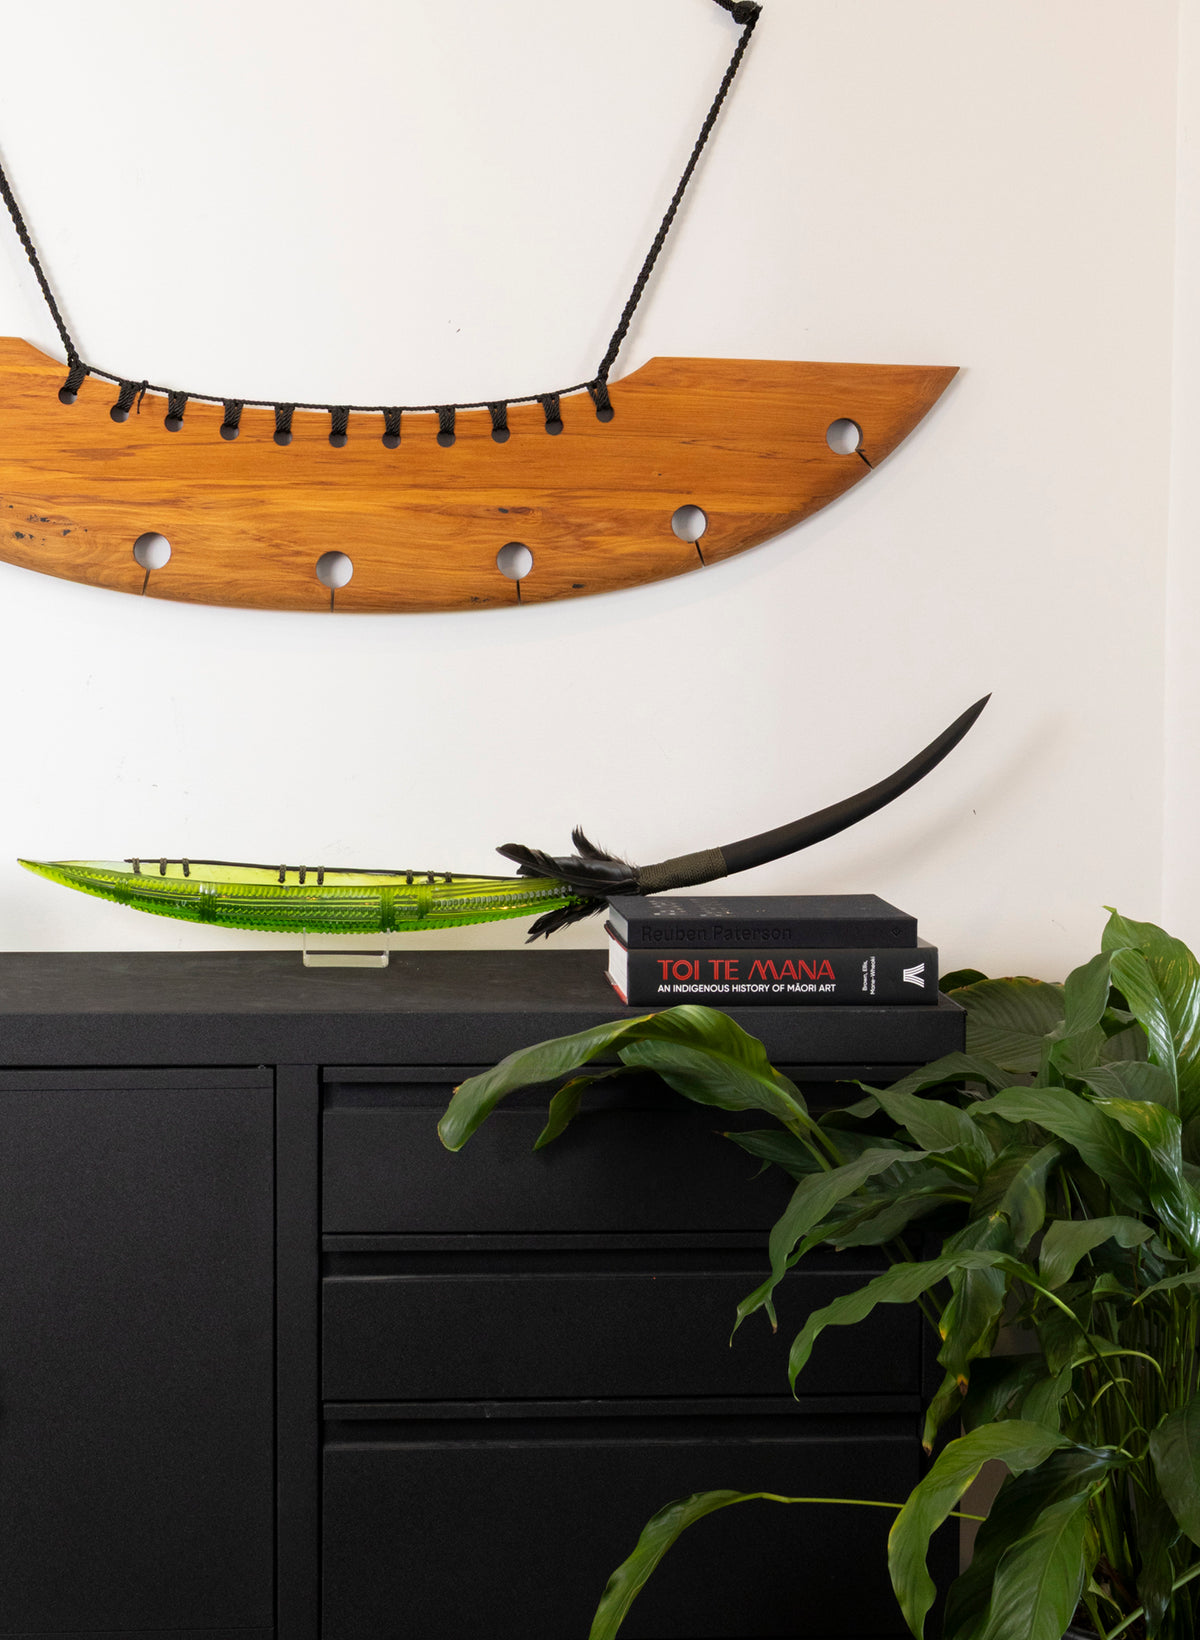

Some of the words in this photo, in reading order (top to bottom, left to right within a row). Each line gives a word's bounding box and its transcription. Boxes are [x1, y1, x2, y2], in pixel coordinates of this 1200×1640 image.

[641, 925, 705, 942] Reuben
[712, 924, 792, 941] Paterson
[657, 960, 699, 980] TOI
[708, 960, 739, 980] TE
[748, 960, 835, 980] MANA
[658, 984, 670, 992] AN
[673, 984, 729, 992] INDIGENOUS
[732, 984, 770, 992] HISTORY
[772, 984, 784, 992] OF
[819, 984, 836, 992] ART
